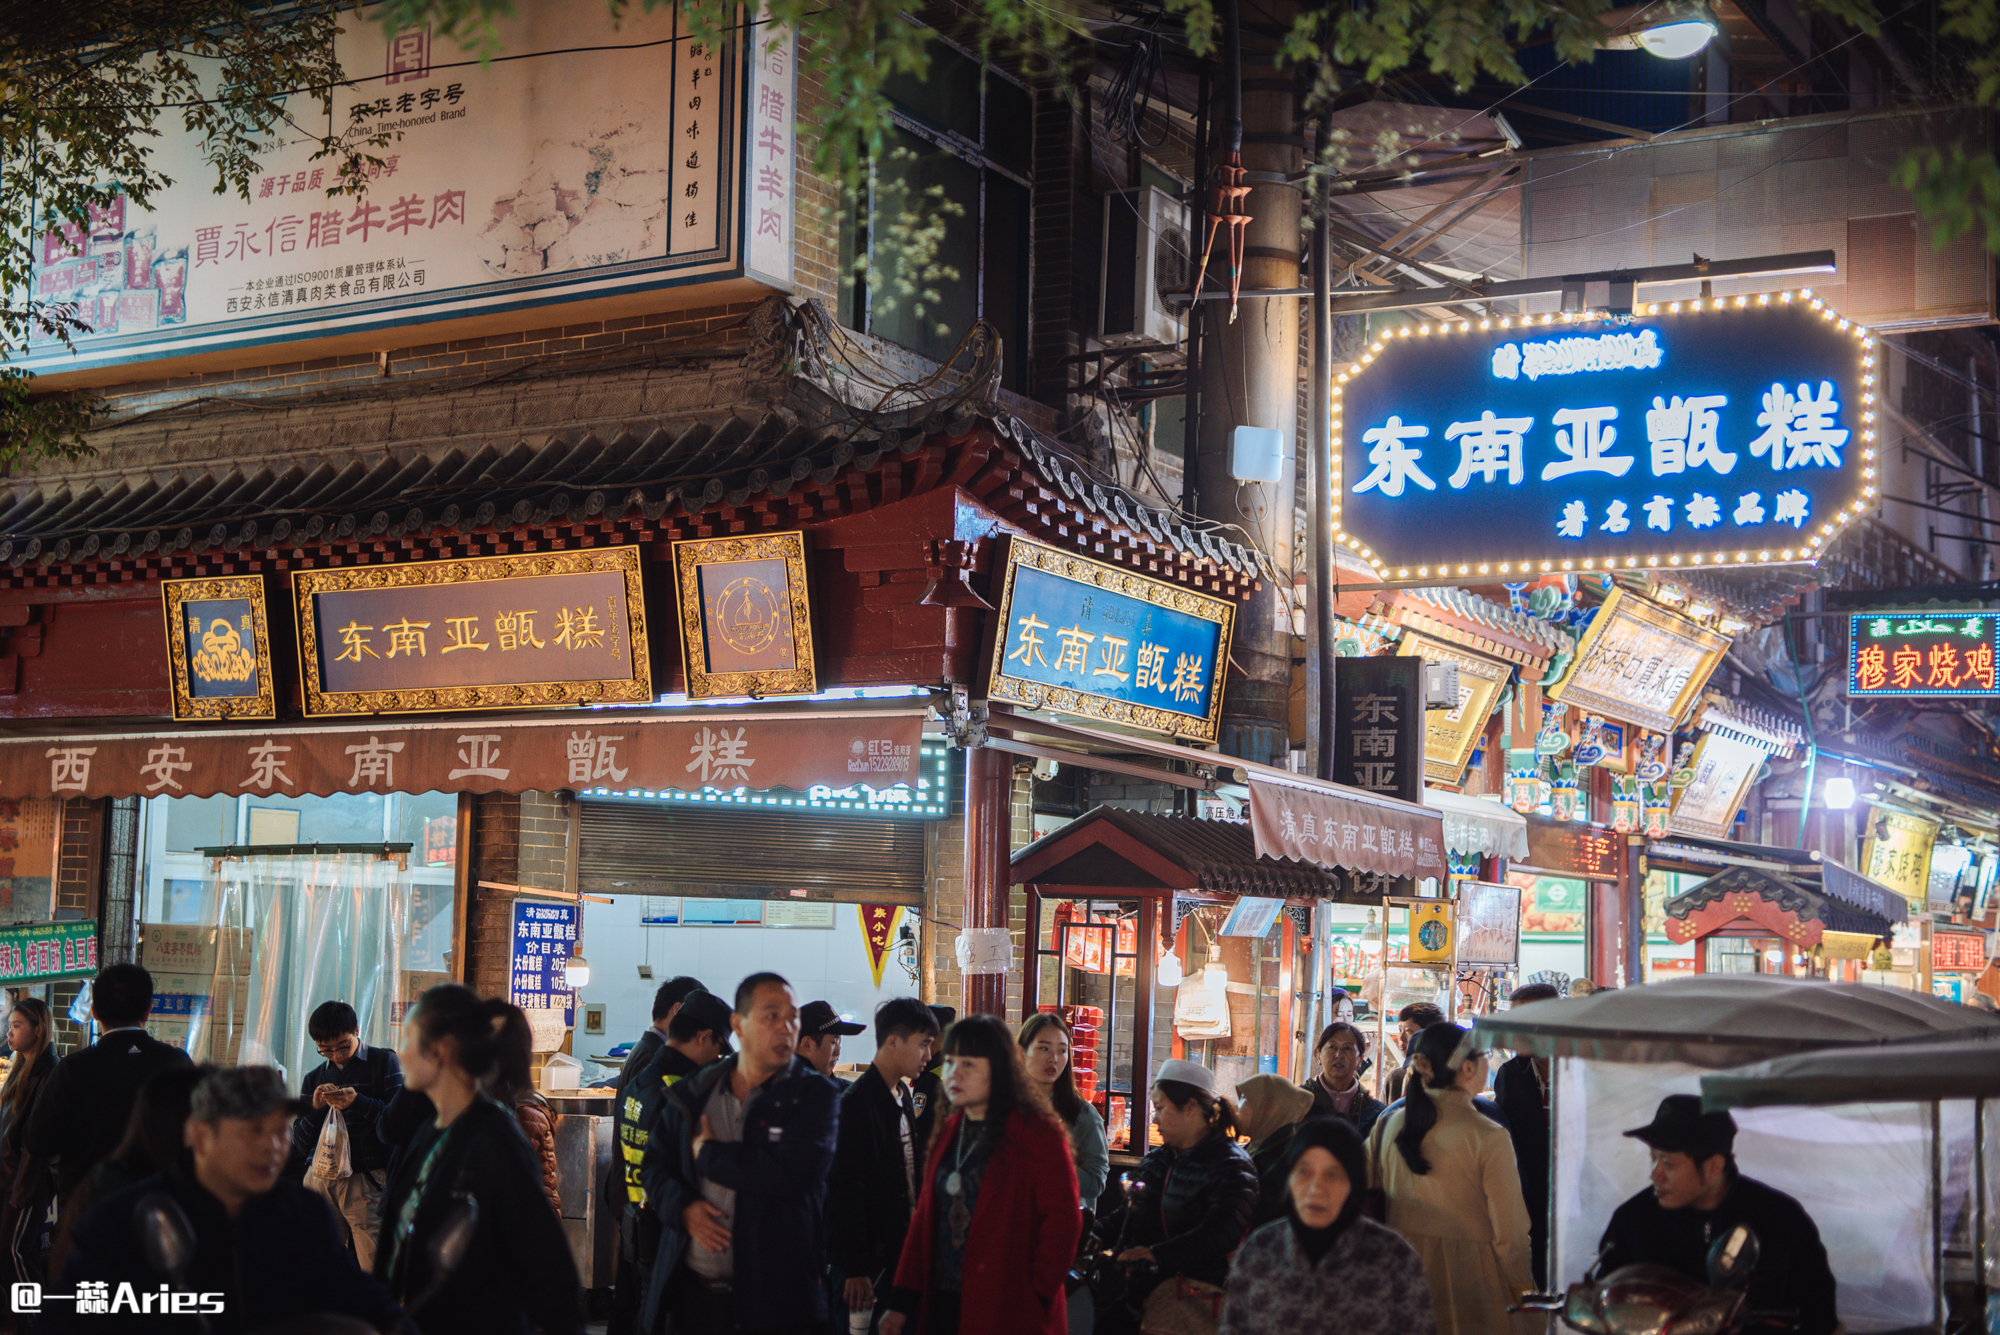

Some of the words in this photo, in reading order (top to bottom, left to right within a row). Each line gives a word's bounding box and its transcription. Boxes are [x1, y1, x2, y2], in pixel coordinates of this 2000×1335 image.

[349, 83, 466, 119] 中华老字号
[349, 125, 372, 138] China
[377, 112, 436, 132] Time-honored
[440, 106, 466, 121] Brand
[258, 167, 325, 198] 源于品质
[227, 269, 427, 314] 西安永信清真肉类食品有限公司
[1352, 380, 1850, 497] 东南亚甑糕
[1557, 488, 1810, 538] 著名商标品牌
[188, 616, 201, 634] 清
[240, 614, 252, 631] 真
[334, 604, 606, 662] 东南亚甑糕
[605, 595, 621, 661] 百年老字号
[1008, 612, 1205, 704] 东南亚甑糕
[1855, 641, 1995, 690] 穆家烧鸡
[45, 726, 756, 793] 西安东南亚甑糕
[1280, 809, 1415, 860] 清真东南亚甑糕
[517, 920, 577, 940] 东南亚甑糕
[560, 908, 569, 920] 真
[872, 907, 887, 946] 族小吃
[26, 938, 61, 977] 烤面筋
[64, 934, 98, 972] 鱼豆腐
[525, 941, 566, 955] 价目表
